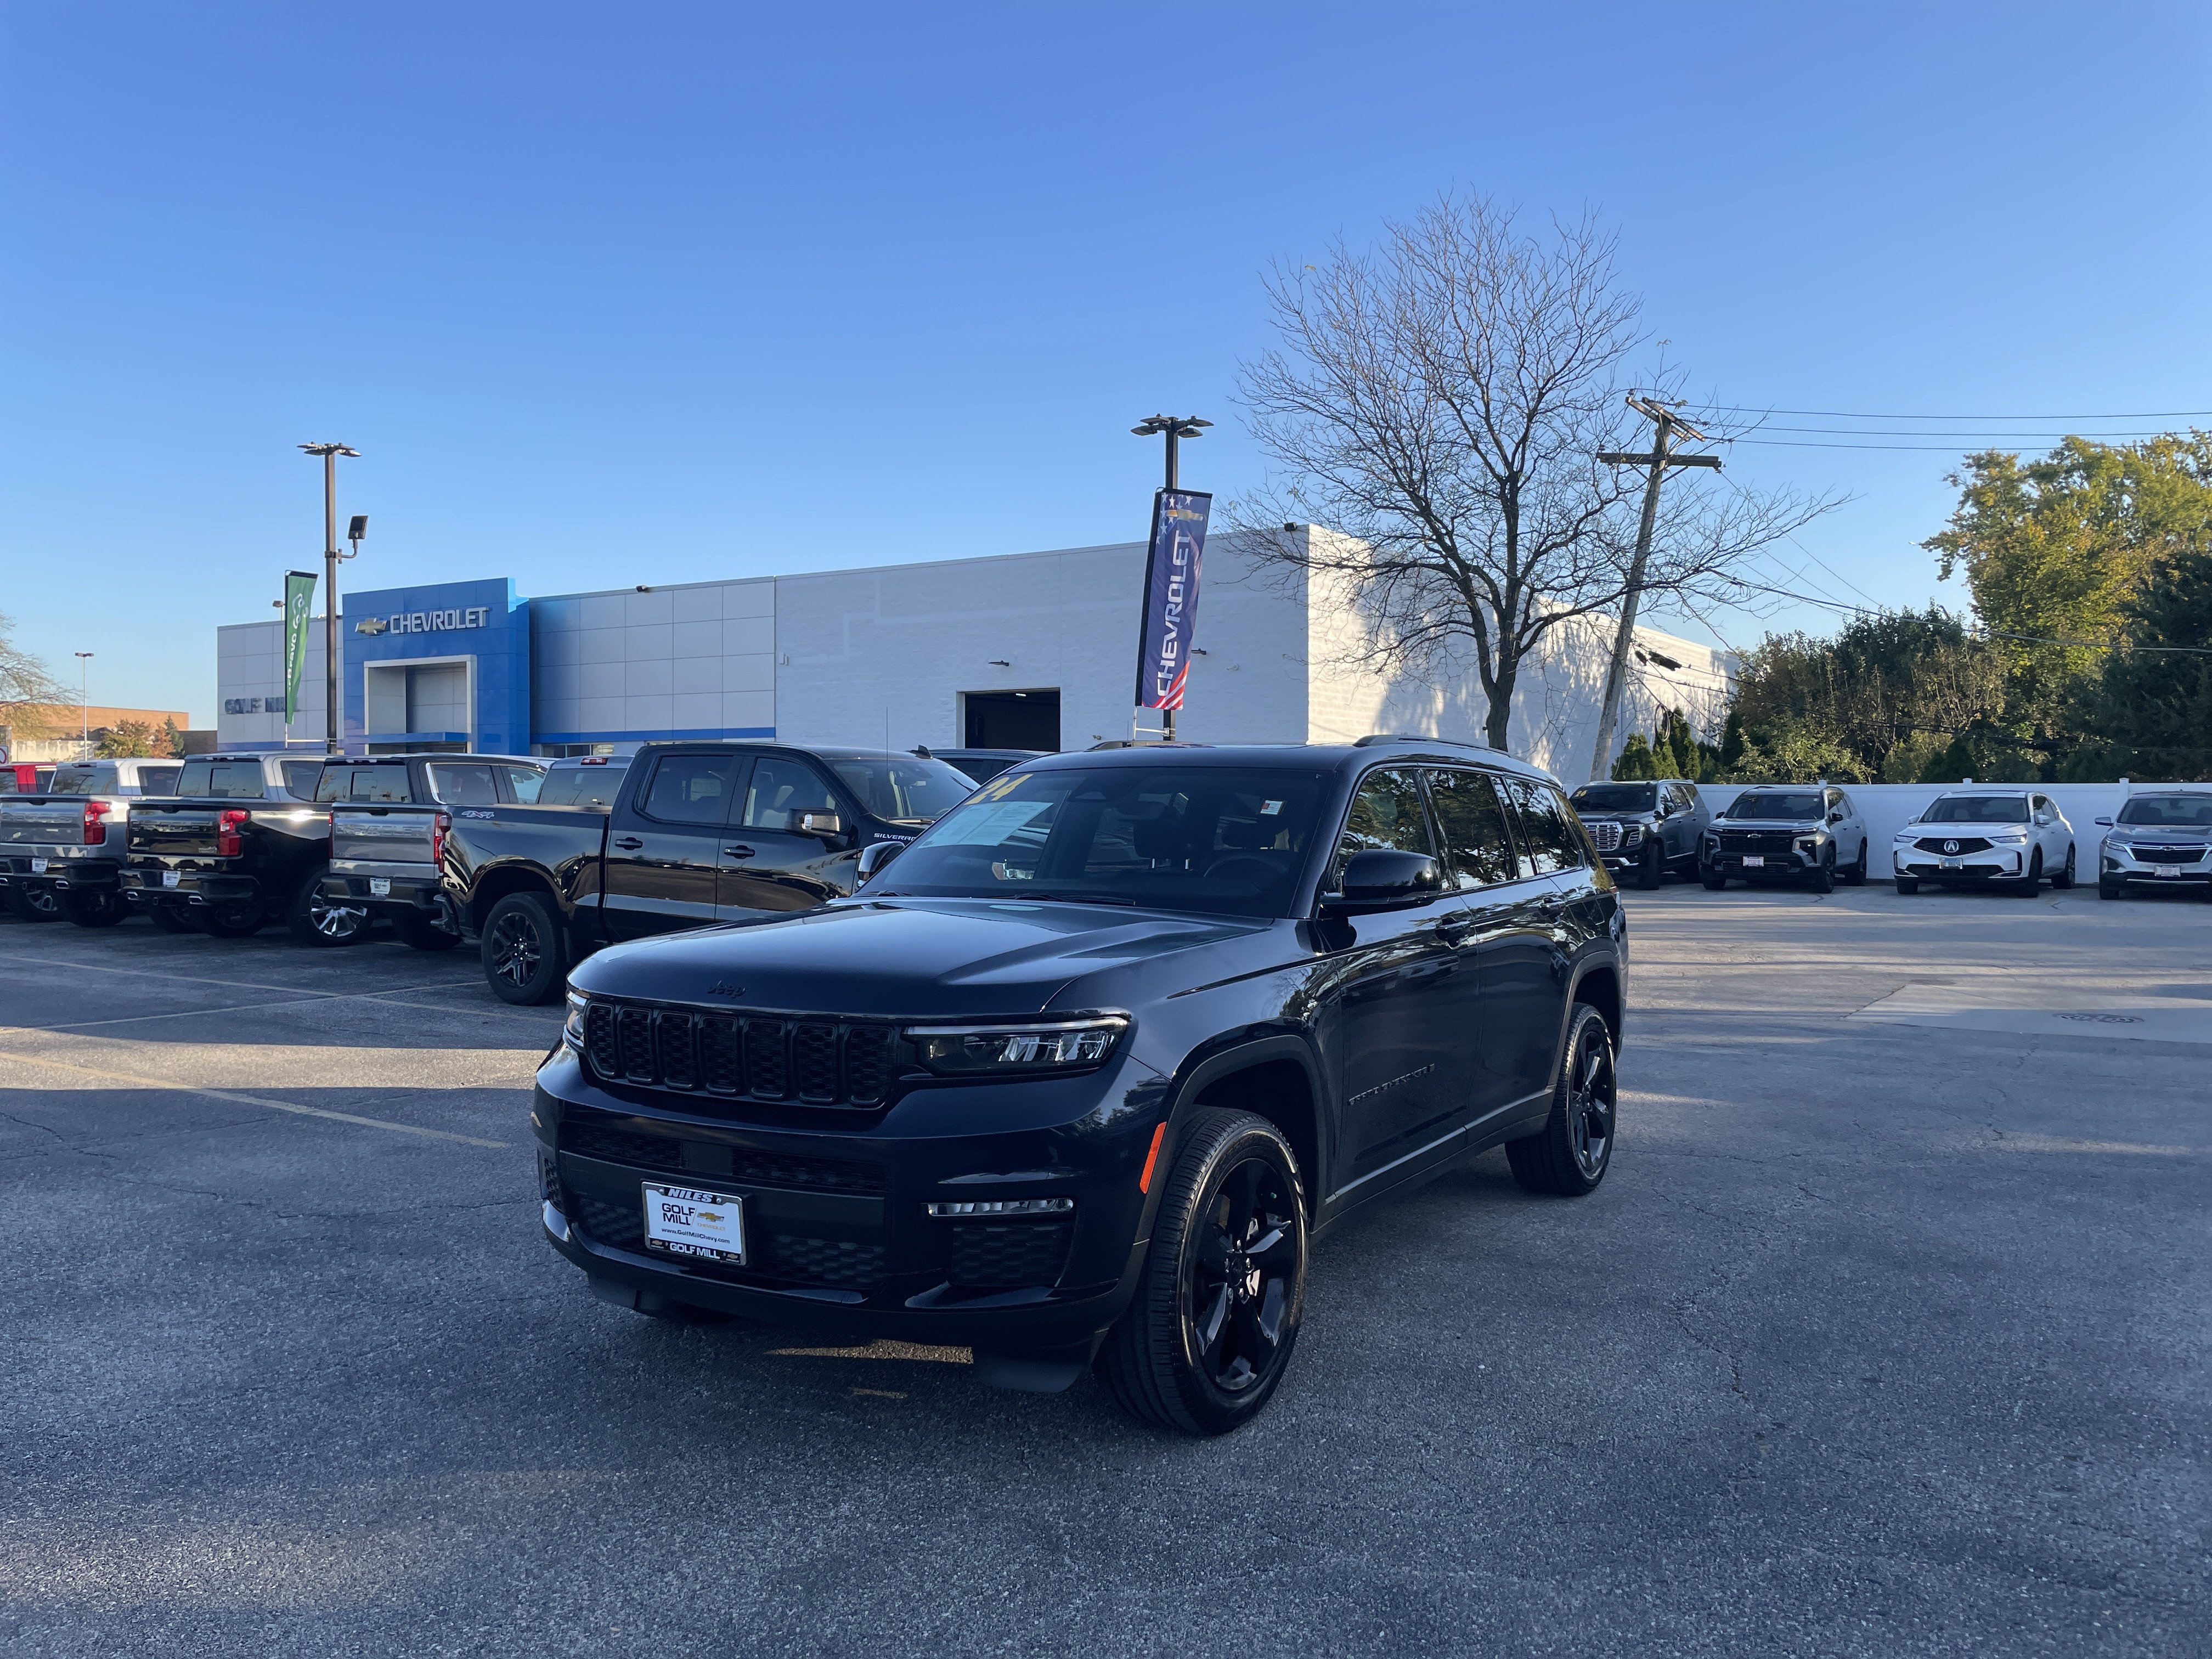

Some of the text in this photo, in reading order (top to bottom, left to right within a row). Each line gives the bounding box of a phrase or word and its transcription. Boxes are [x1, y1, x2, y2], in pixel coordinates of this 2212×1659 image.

[390, 607, 487, 634] CHEVROLET
[1157, 530, 1191, 697] CHEVROLET
[963, 774, 1034, 805] 24
[707, 980, 747, 999] Jeep
[668, 1188, 713, 1203] NILES
[662, 1203, 696, 1216] GOLF
[663, 1212, 691, 1226] MILL
[697, 1222, 726, 1231] CHEVROLET
[661, 1227, 731, 1244] www.GolfMillChevy.com
[669, 1242, 720, 1260] GOLF MILL
